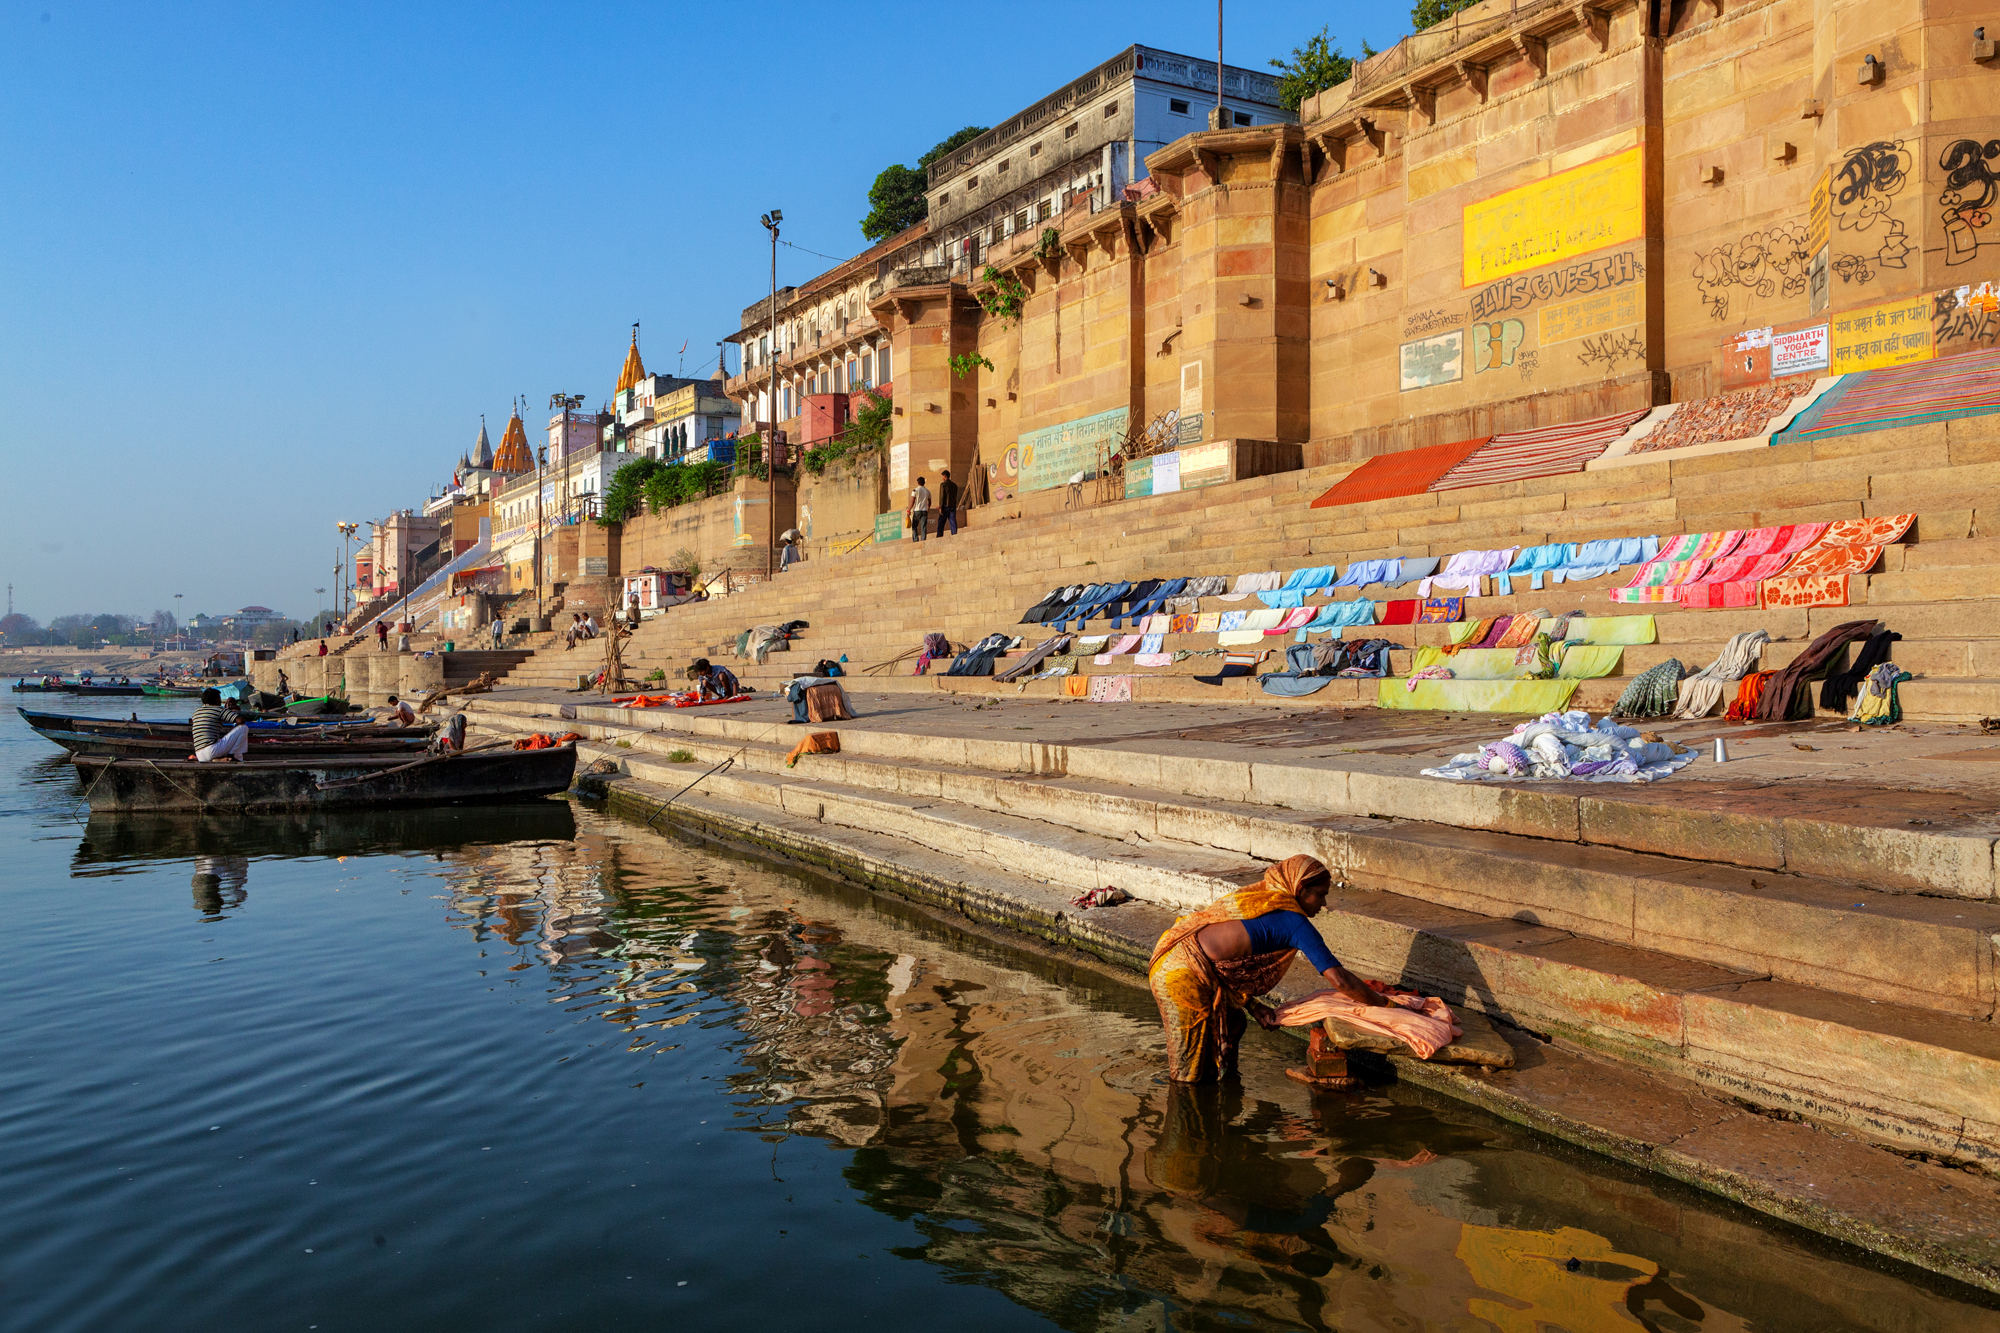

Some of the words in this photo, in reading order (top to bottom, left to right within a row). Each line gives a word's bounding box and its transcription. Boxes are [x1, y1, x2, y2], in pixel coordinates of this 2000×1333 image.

[1835, 319, 1852, 333] गंगा
[1853, 316, 1873, 333] अमृत
[1875, 310, 1887, 327] की
[1888, 309, 1906, 326] जल
[1773, 329, 1824, 346] SIDDHARTH
[1870, 339, 1883, 355] का
[1884, 332, 1901, 354] नहीं
[1776, 347, 1817, 362] CENTRE
[1784, 341, 1809, 352] YOGA
[1076, 422, 1096, 440] निगम
